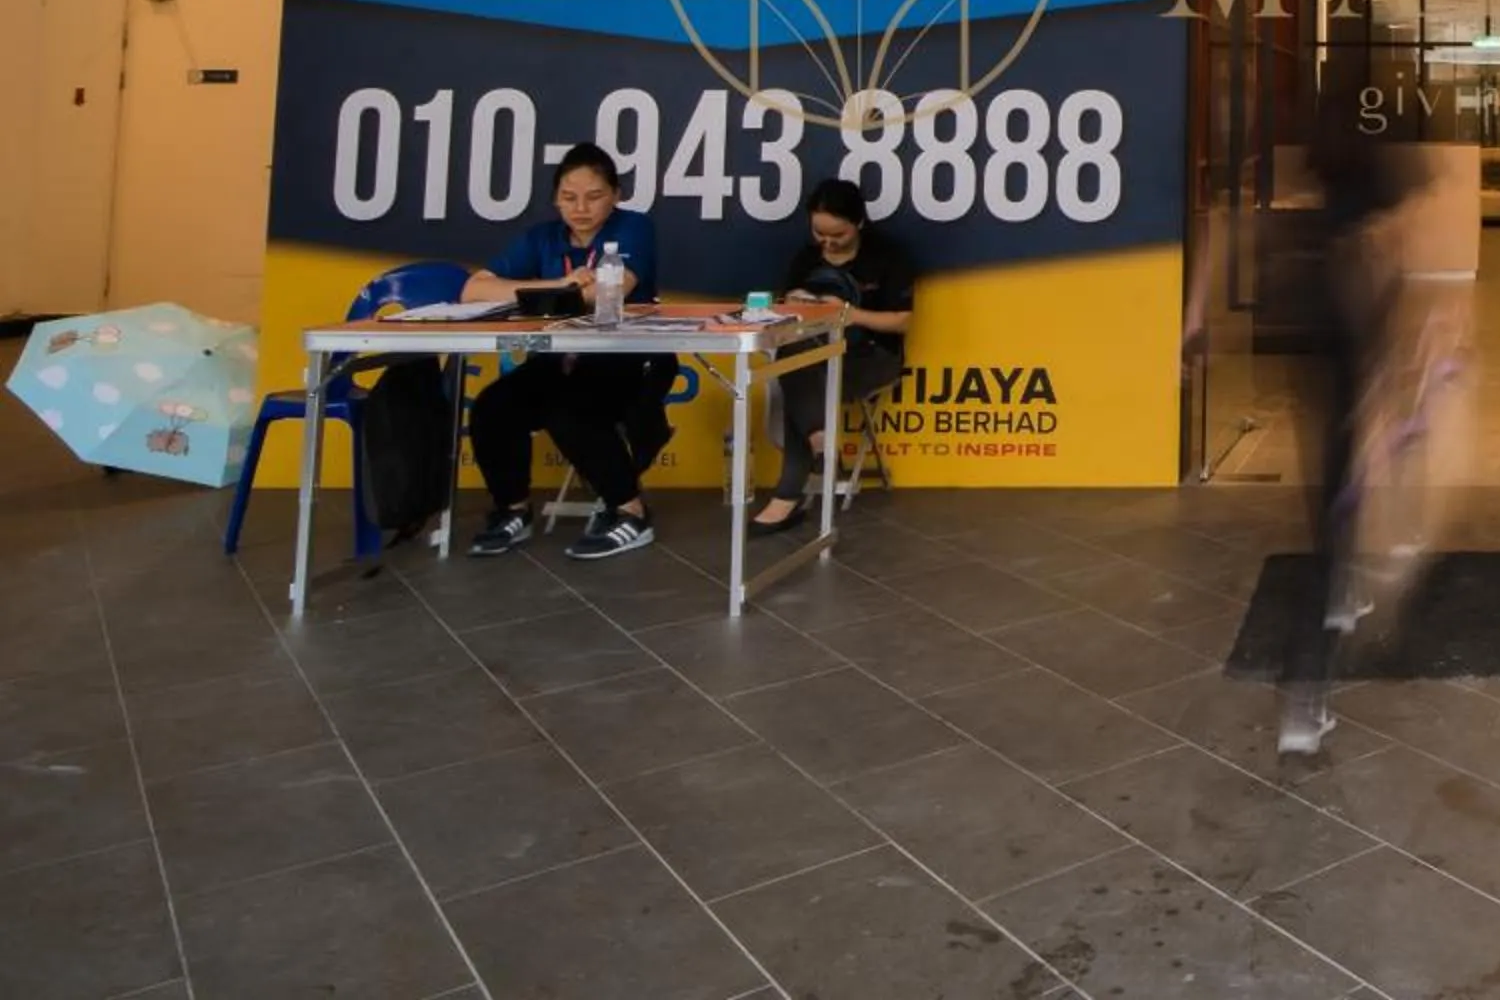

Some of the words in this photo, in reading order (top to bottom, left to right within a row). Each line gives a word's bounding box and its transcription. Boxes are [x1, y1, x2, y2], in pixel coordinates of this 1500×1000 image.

[333, 87, 805, 221] 010-943
[838, 88, 1123, 222] 8888
[866, 367, 1057, 405] TIJAYA
[935, 410, 1057, 434] BERHAD
[918, 442, 950, 457] TO
[956, 443, 1057, 458] INSPIRE
